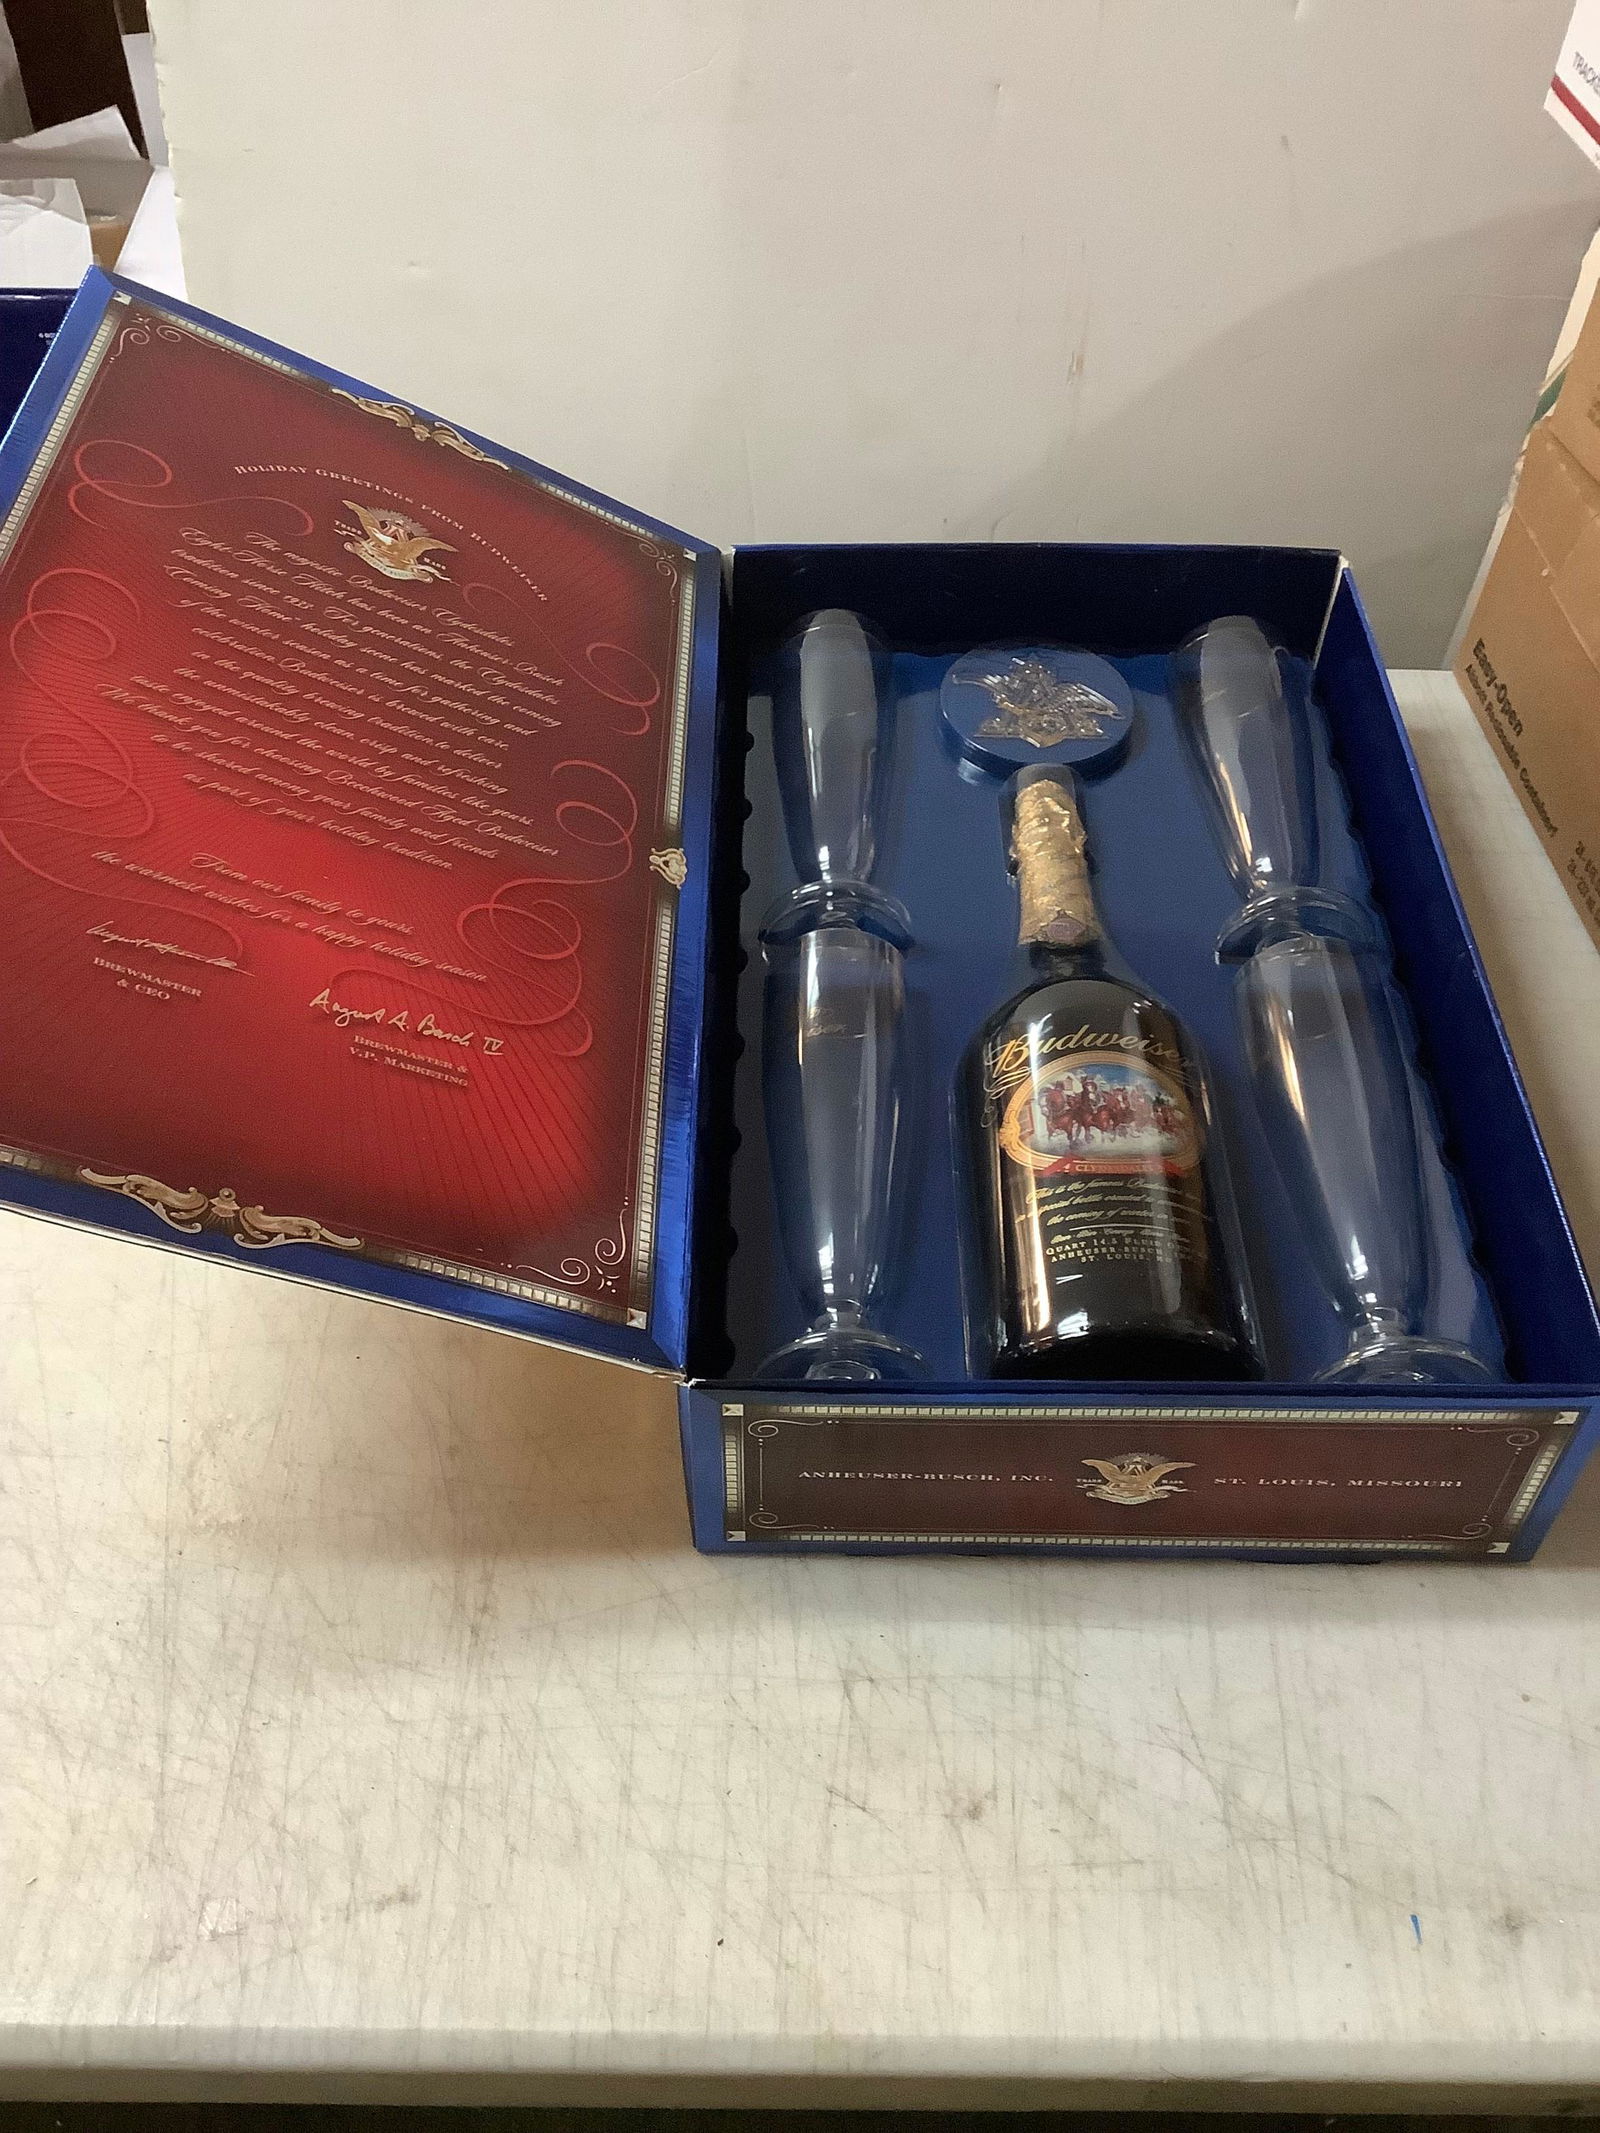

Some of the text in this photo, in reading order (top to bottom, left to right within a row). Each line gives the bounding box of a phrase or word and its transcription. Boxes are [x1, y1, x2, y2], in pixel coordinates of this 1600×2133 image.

[234, 465, 547, 601] HOLIDAY GREETINGS FROM BUDWEISER
[179, 527, 287, 575] Eight-Horse
[291, 573, 348, 599] Hitch
[347, 598, 376, 611] has
[376, 610, 409, 624] been
[412, 624, 432, 634] an
[246, 531, 281, 551] The
[283, 552, 343, 576] majestic
[346, 575, 427, 611] Budweiser
[432, 608, 515, 646] Clydesdales
[170, 549, 239, 578] tradition
[241, 578, 280, 594] since
[323, 606, 359, 626] For
[449, 659, 473, 670] the
[477, 667, 559, 705] Clydesdales
[167, 599, 214, 616] of
[200, 601, 227, 617] the
[228, 618, 280, 639] winter
[282, 639, 331, 659] season
[334, 659, 354, 668] as
[370, 672, 404, 686] time
[387, 678, 428, 703] for
[417, 695, 500, 725] gathering
[503, 723, 538, 736] and
[300, 623, 358, 648] holiday
[359, 647, 398, 662] scene
[400, 661, 428, 674] has
[430, 674, 492, 700] marked
[487, 690, 510, 705] the
[512, 706, 562, 727] coming
[191, 651, 210, 659] in
[214, 659, 241, 671] the
[238, 671, 300, 695] quality
[302, 692, 365, 719] brewing
[435, 741, 450, 749] to
[453, 749, 502, 769] deliver
[277, 657, 365, 695] Budweiser
[367, 694, 384, 702] is
[385, 700, 445, 726] brewed
[440, 716, 478, 736] with
[129, 675, 170, 692] taste
[169, 693, 241, 722] enjoyed
[234, 711, 301, 744] around
[296, 733, 323, 749] the
[325, 749, 374, 768] world
[368, 761, 396, 781] by
[383, 772, 459, 799] families
[461, 796, 490, 809] like
[173, 668, 201, 679] the
[203, 680, 311, 723] unmistakably
[359, 738, 398, 754] crisp
[401, 753, 440, 770] and
[429, 764, 508, 795] refreshing
[97, 683, 559, 856] We thank you for choosing Beechwood Aged Budweiser
[182, 773, 206, 787] as
[198, 777, 252, 798] part
[150, 734, 499, 858] to be shared among your family and friends
[235, 788, 285, 815] of
[259, 804, 315, 822] your
[318, 819, 380, 846] holiday
[190, 852, 248, 880] From
[252, 880, 283, 892] our
[91, 851, 122, 864] the
[124, 863, 206, 892] warmest
[204, 890, 262, 912] wishes
[241, 908, 292, 922] for
[311, 924, 367, 947] happy
[369, 941, 433, 967] holiday
[265, 889, 342, 914] family
[345, 909, 363, 918] to
[93, 957, 202, 997] BREWMASTER
[117, 979, 170, 999] & CEO
[309, 988, 504, 1055] August A. Busch IV
[350, 1046, 468, 1086] V.P. MARKETING
[354, 1035, 468, 1073] BREWMASTER &
[1045, 1241, 1087, 1255] QUART
[798, 1471, 1053, 1482] ANHEUSER-BUSCH, INC.
[1258, 1479, 1336, 1487] LOUIS,
[1347, 1479, 1463, 1488] MISSOURI
